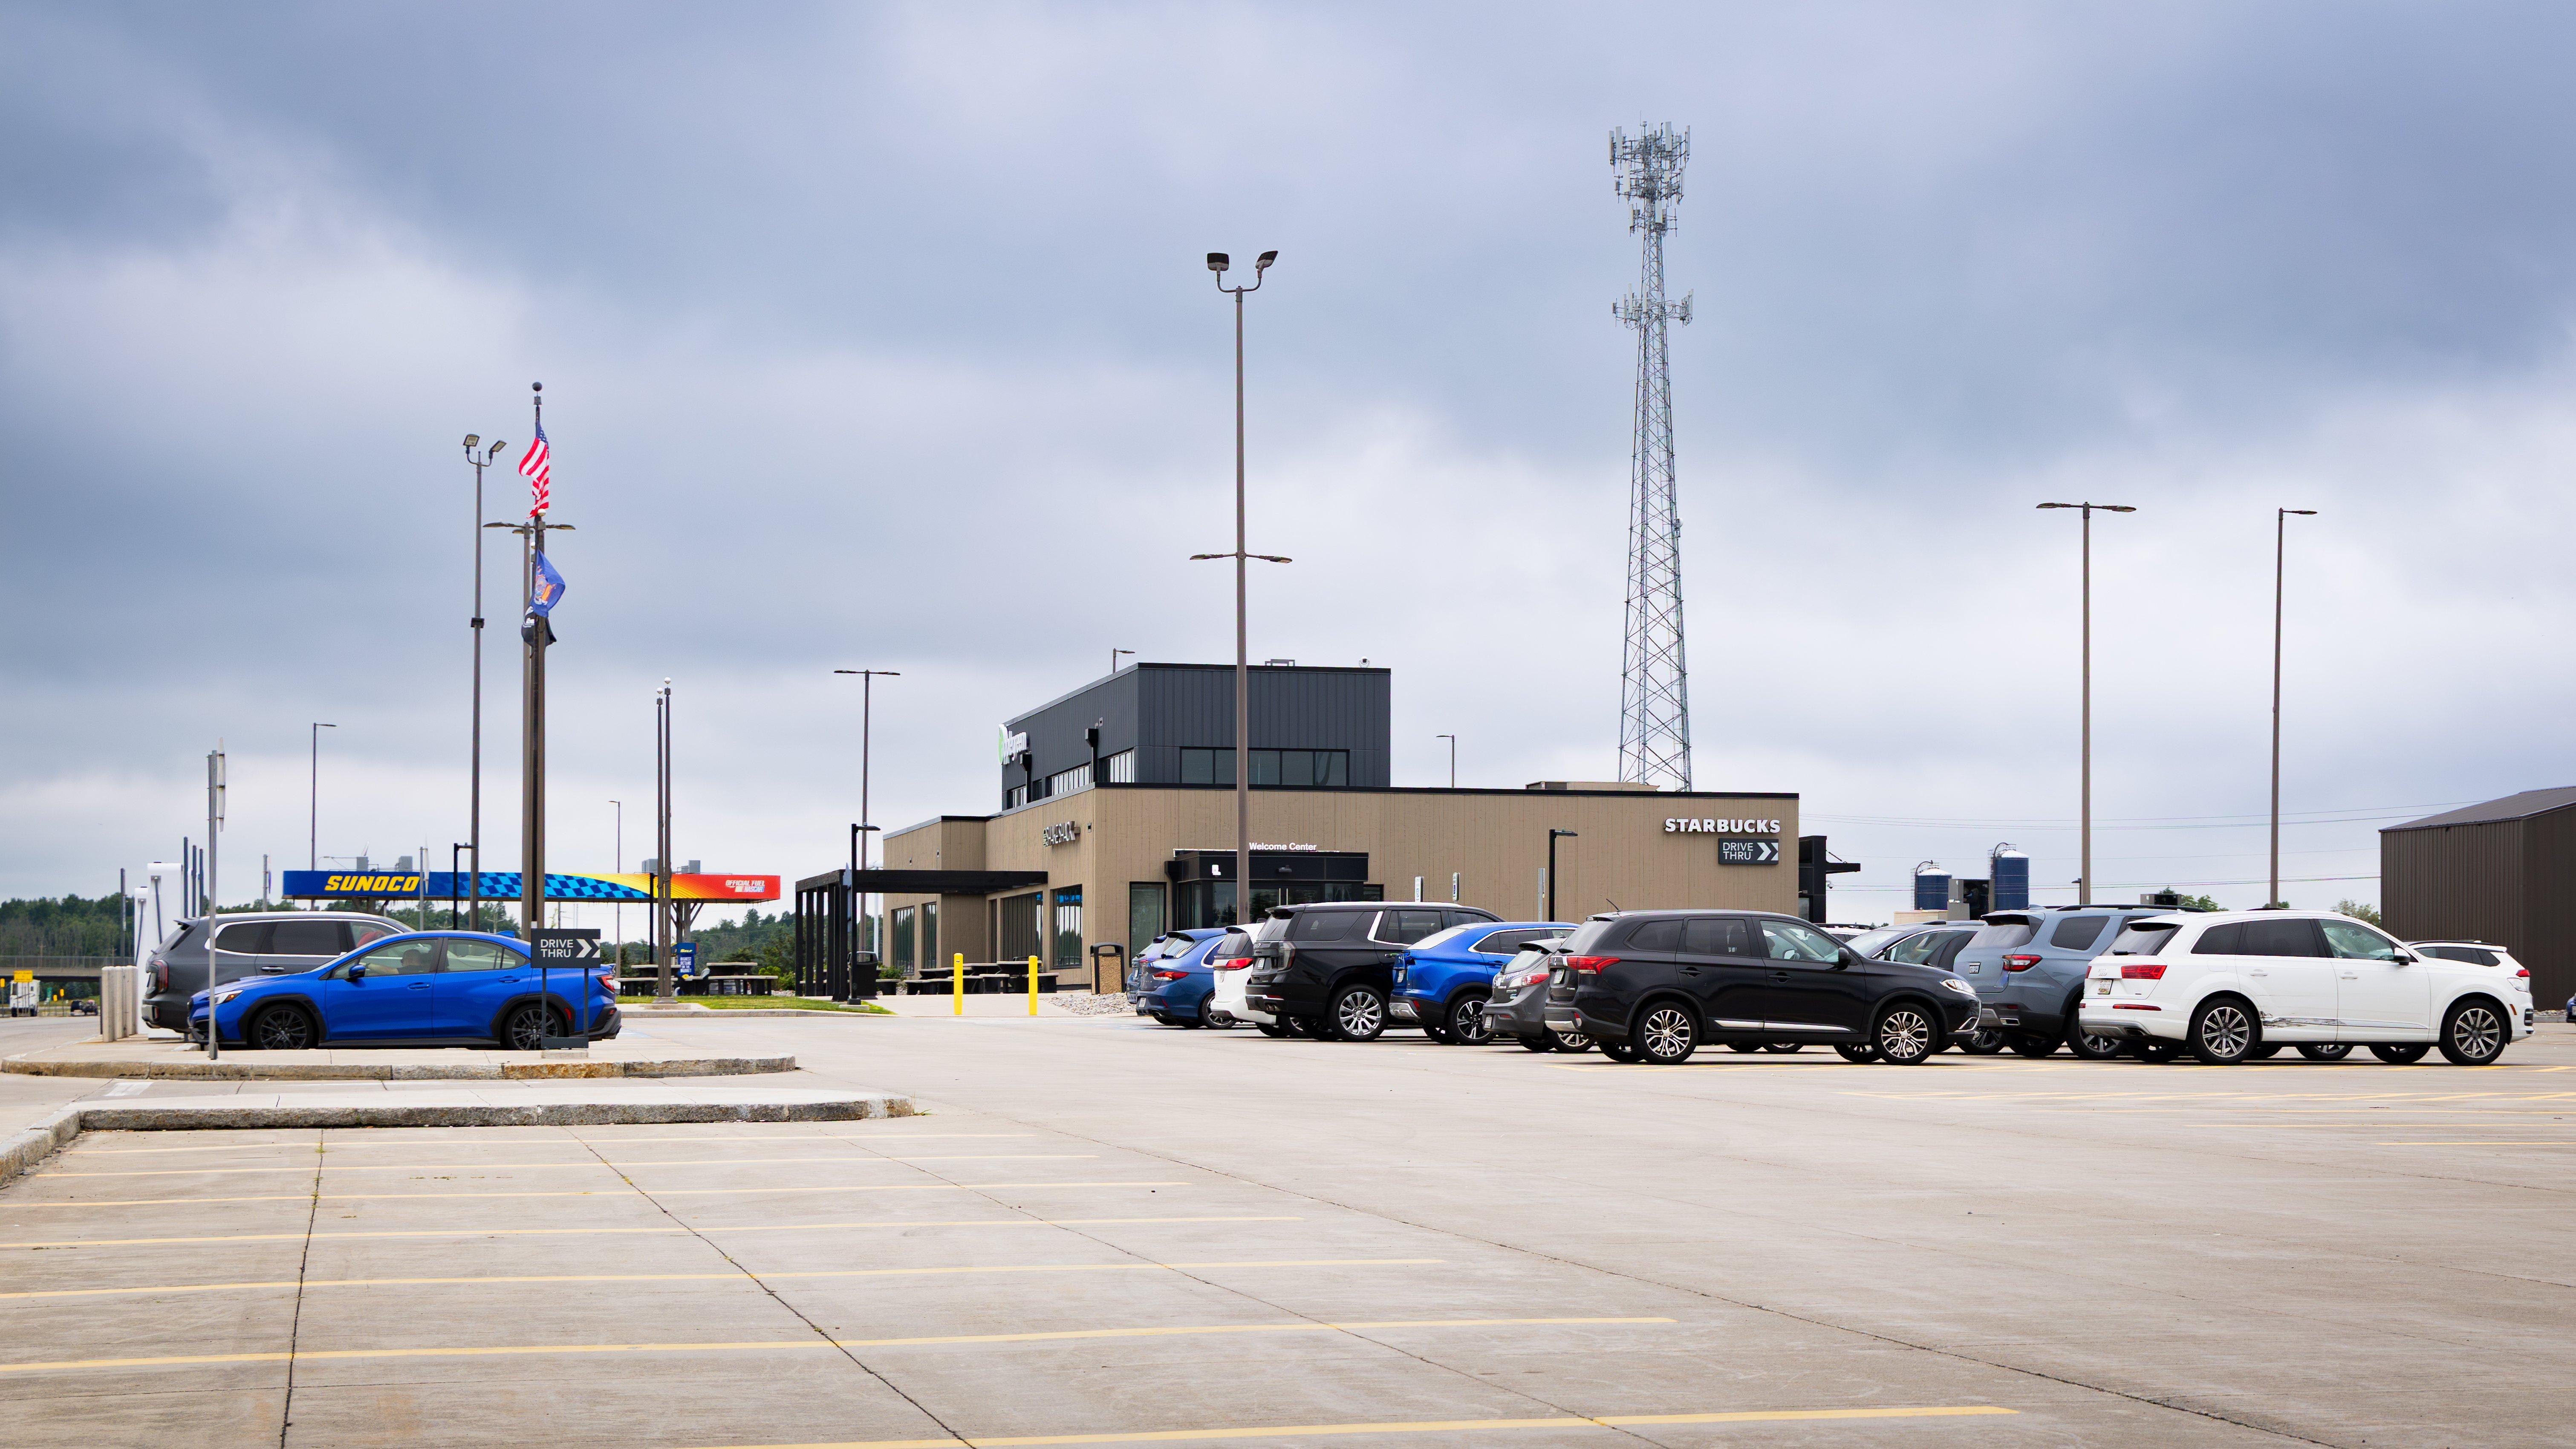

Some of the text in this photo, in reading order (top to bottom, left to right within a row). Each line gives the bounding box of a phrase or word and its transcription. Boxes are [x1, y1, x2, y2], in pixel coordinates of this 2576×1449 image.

[1665, 818, 1780, 833] STARBUCKS
[1249, 842, 1317, 850] Welcome Center
[1723, 842, 1753, 851] DRIVE
[1723, 852, 1751, 860] THRU
[324, 875, 420, 891] SUNOCO
[540, 939, 574, 948] DRIVE
[540, 949, 571, 958] THRU
